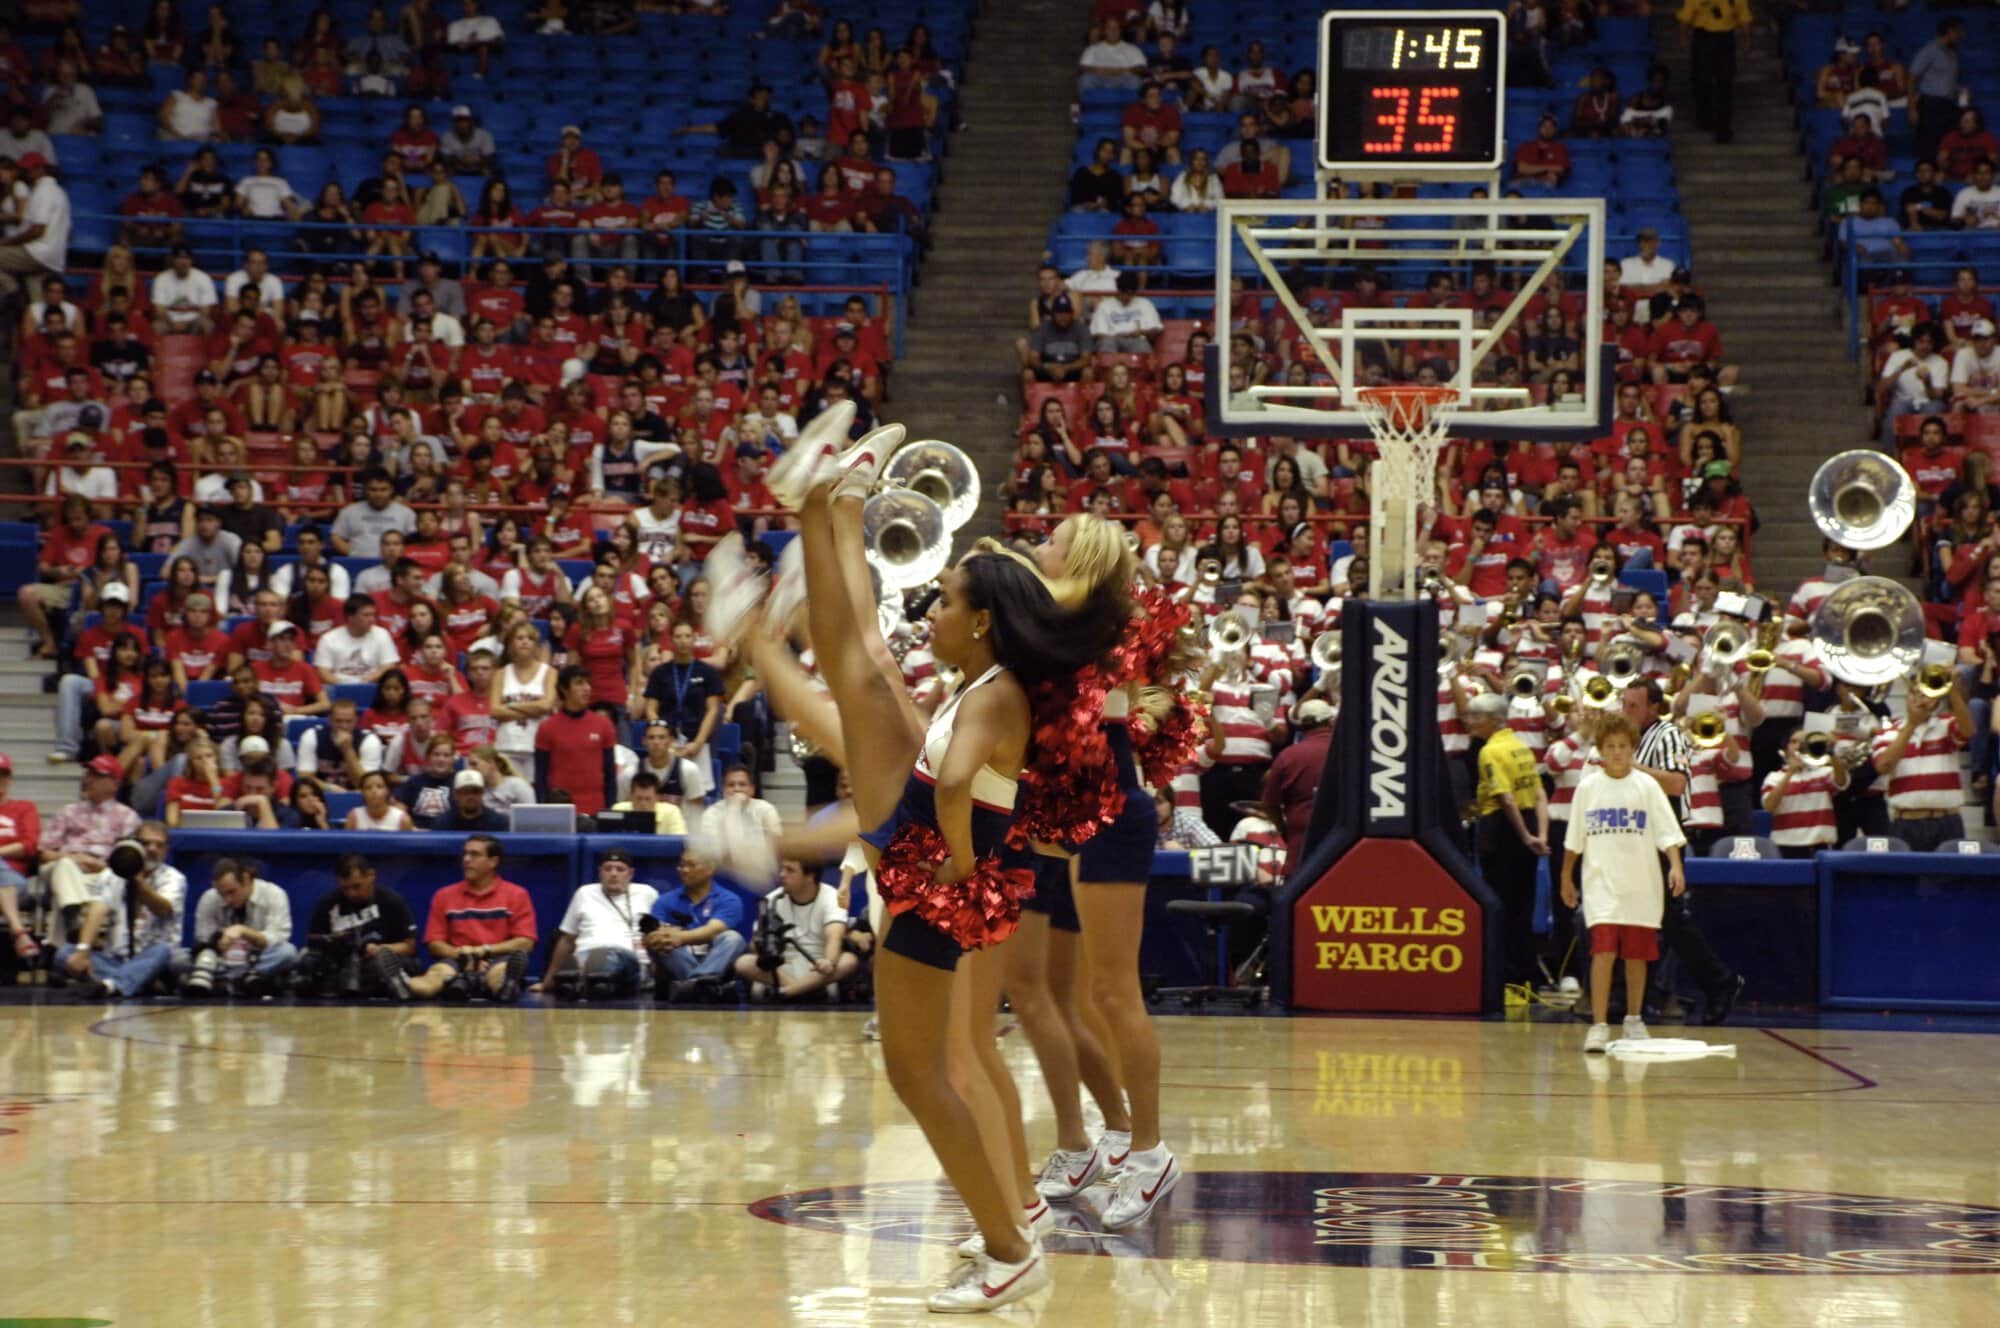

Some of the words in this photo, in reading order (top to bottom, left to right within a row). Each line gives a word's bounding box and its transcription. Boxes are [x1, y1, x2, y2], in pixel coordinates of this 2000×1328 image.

[1391, 28, 1484, 70] 1:45
[1363, 87, 1461, 154] 35
[1370, 617, 1409, 820] ARIZONA
[1192, 846, 1258, 882] FSN
[1309, 906, 1466, 937] WELLS
[1314, 942, 1463, 973] FARGO
